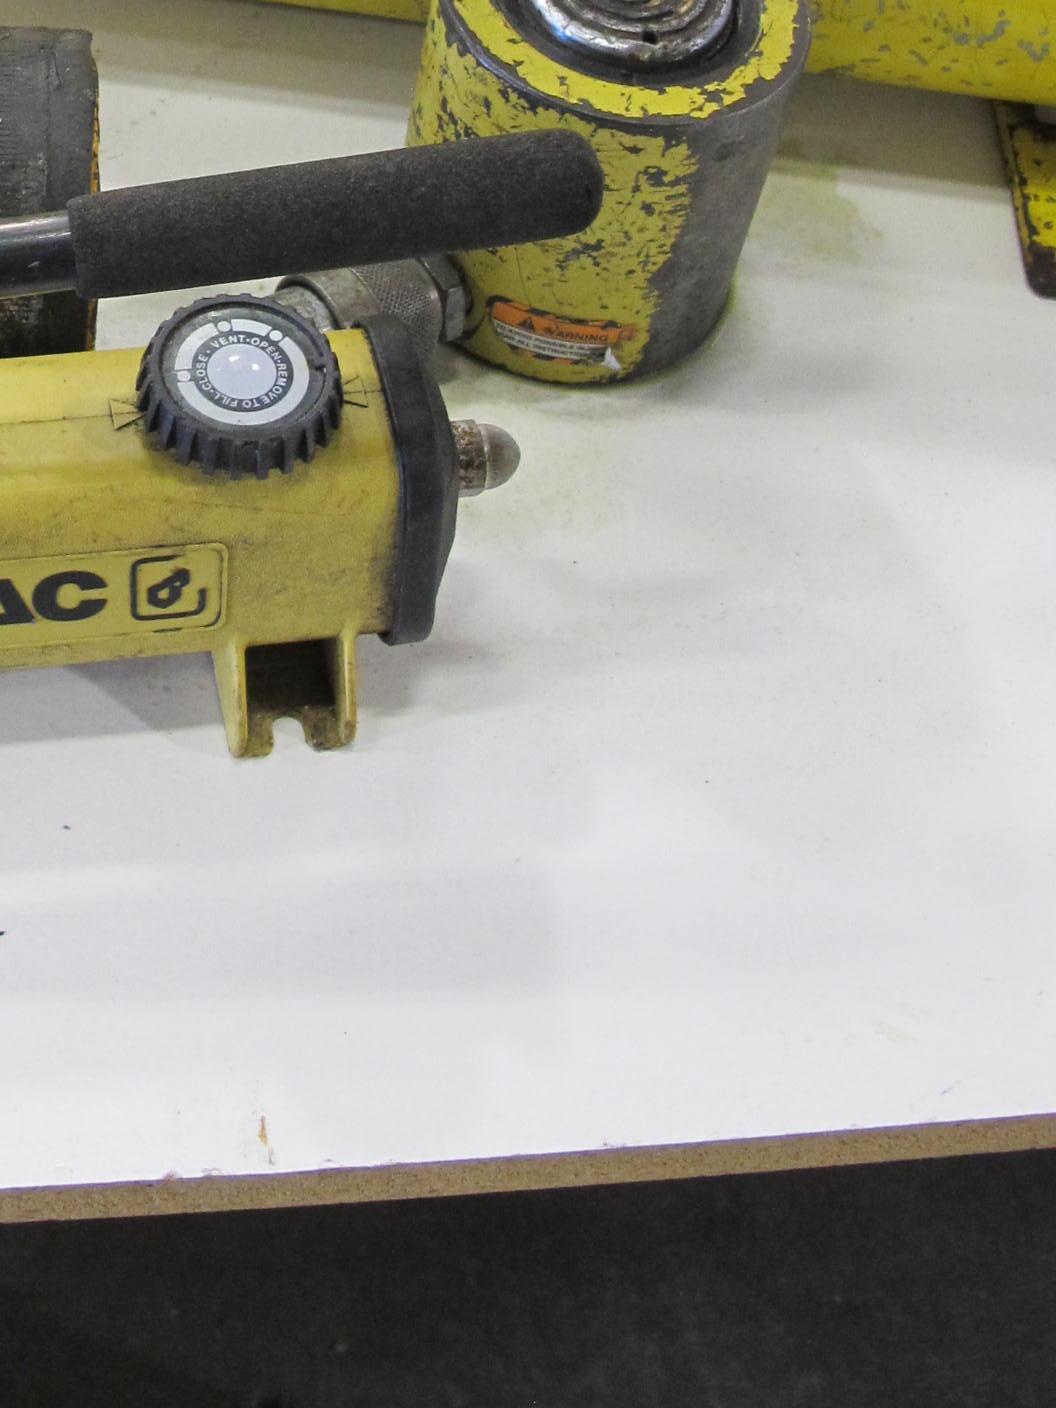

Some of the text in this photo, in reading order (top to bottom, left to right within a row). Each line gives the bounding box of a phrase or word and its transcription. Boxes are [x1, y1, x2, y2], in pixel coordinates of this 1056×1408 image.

[195, 335, 288, 409] VENT OPEN REMOVE TO FILL CLOSE
